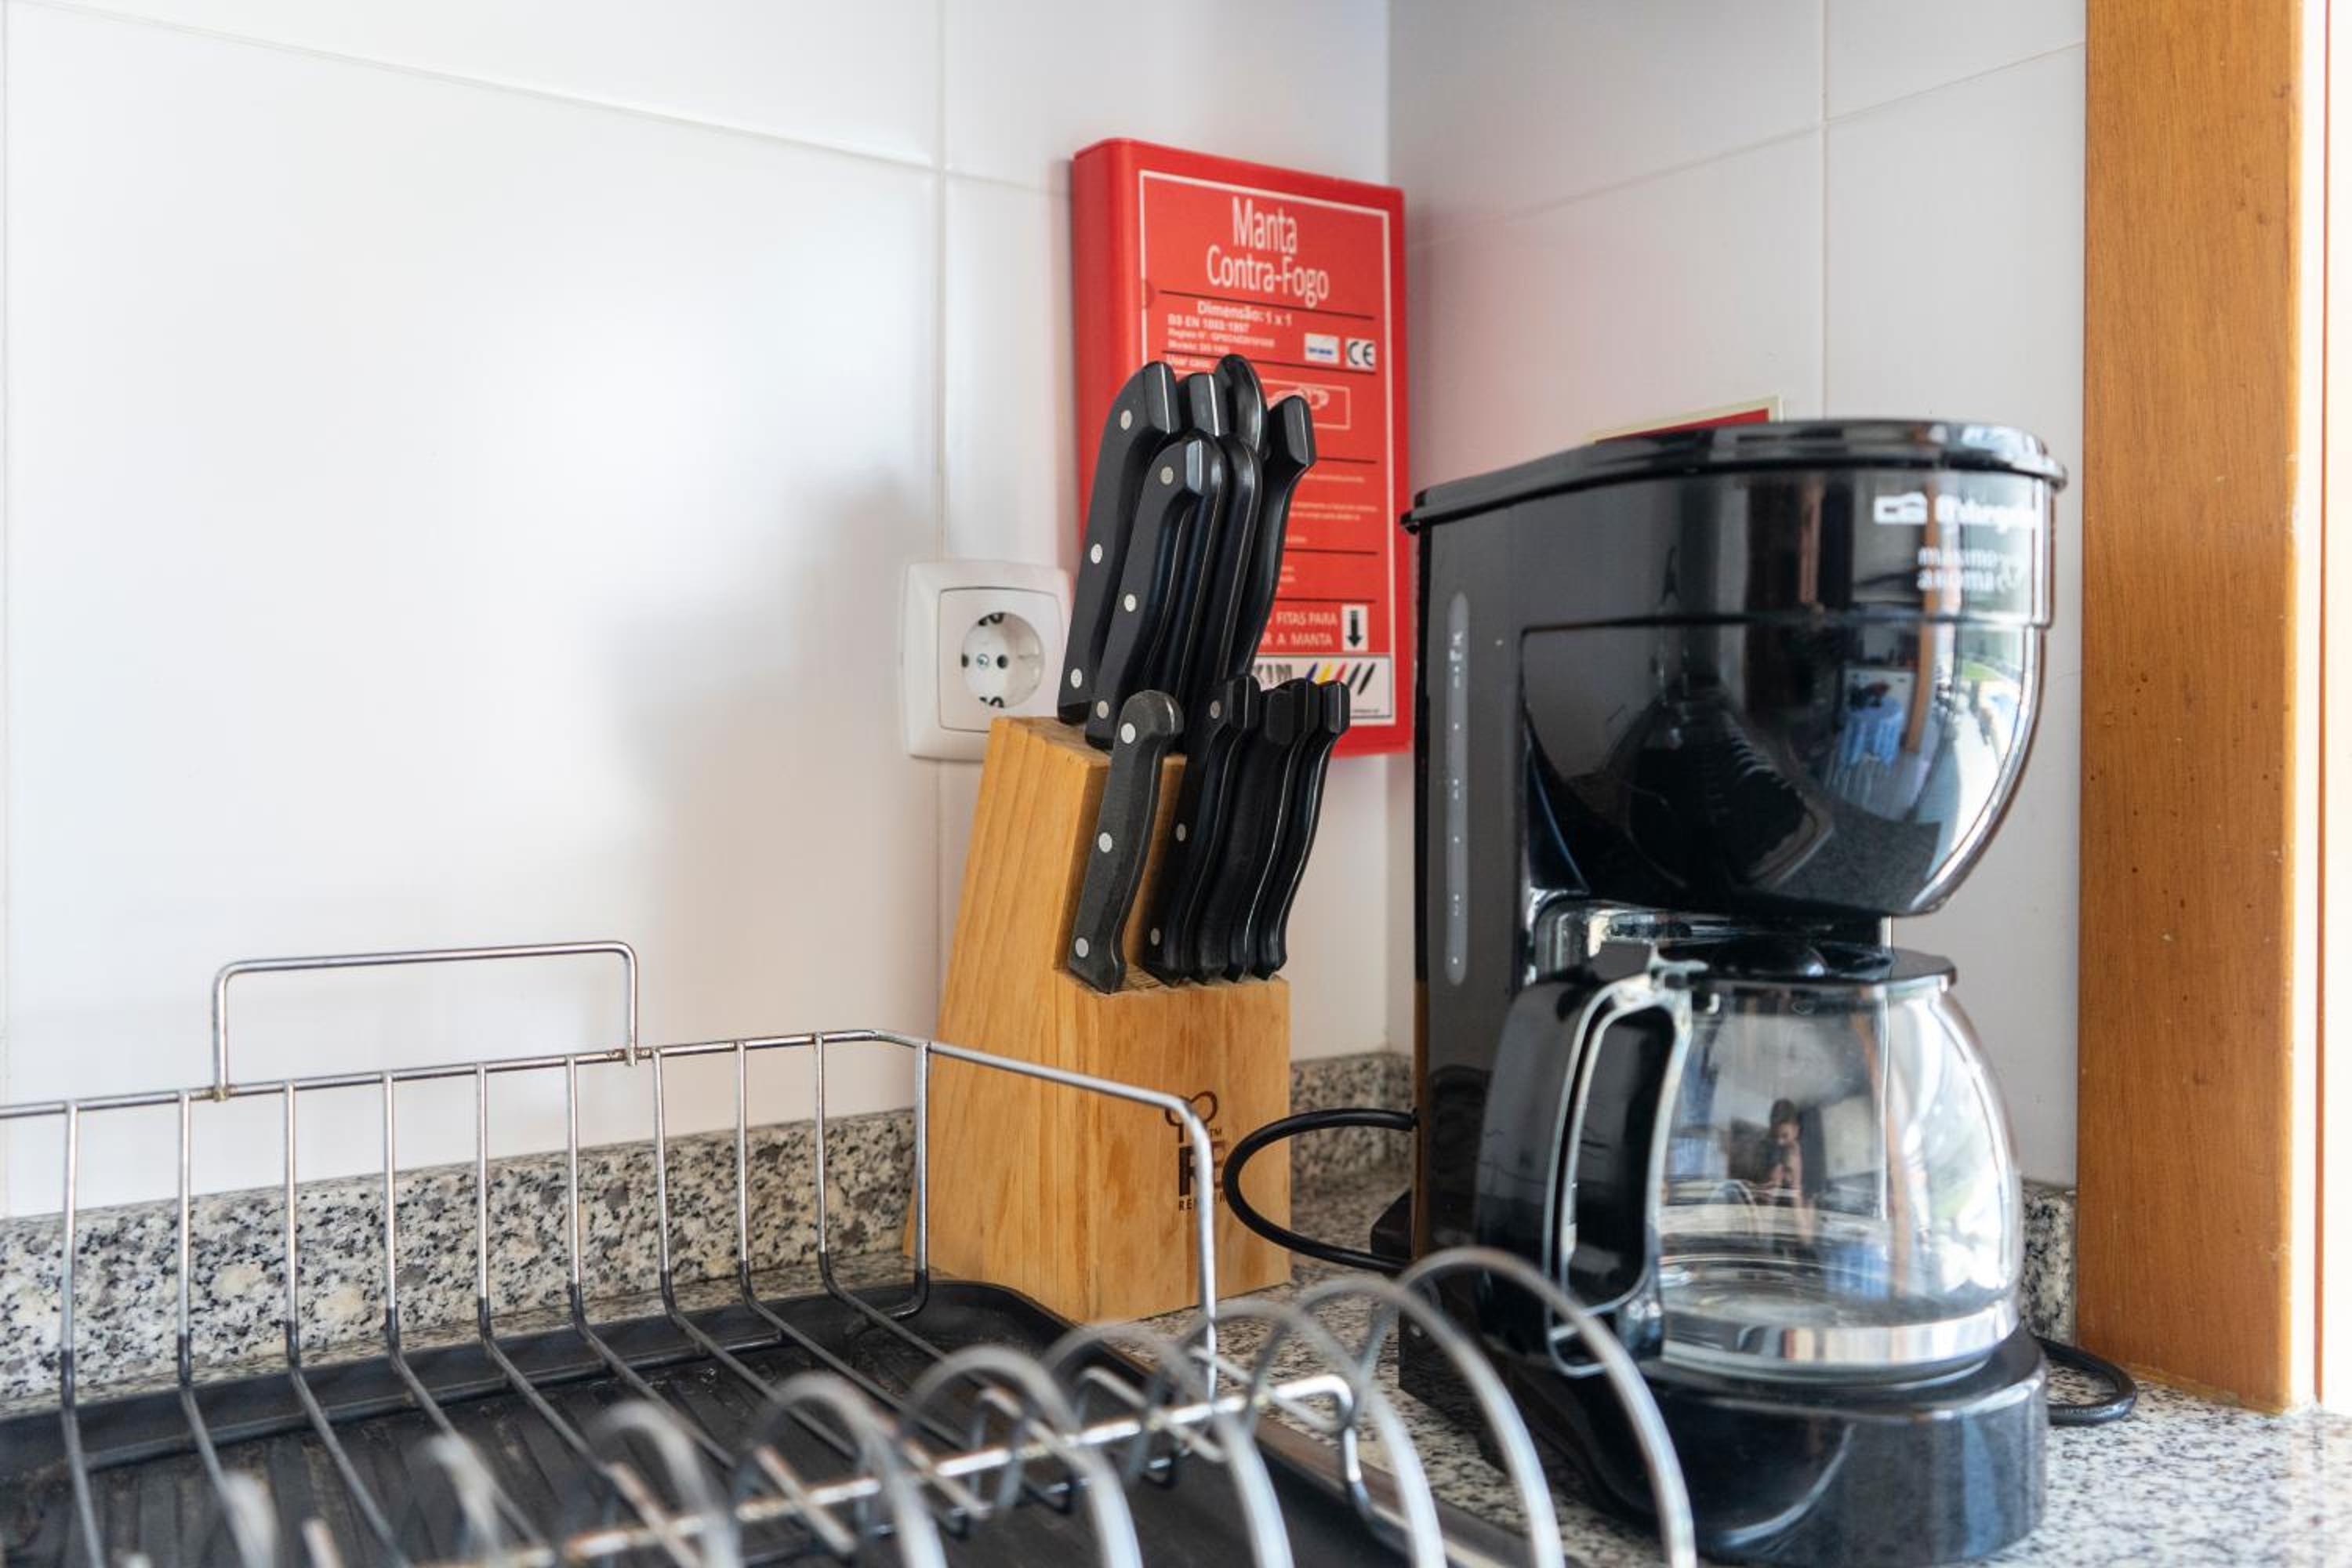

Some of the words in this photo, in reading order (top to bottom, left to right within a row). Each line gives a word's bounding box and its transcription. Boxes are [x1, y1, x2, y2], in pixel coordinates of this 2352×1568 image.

[1232, 196, 1298, 254] Manta
[1207, 244, 1330, 309] Contra-Fogo
[1347, 340, 1374, 366] CE
[1276, 611, 1307, 626] FITAS
[1308, 612, 1338, 626] PARA
[1277, 633, 1286, 645] A
[1290, 633, 1333, 645] MANTA
